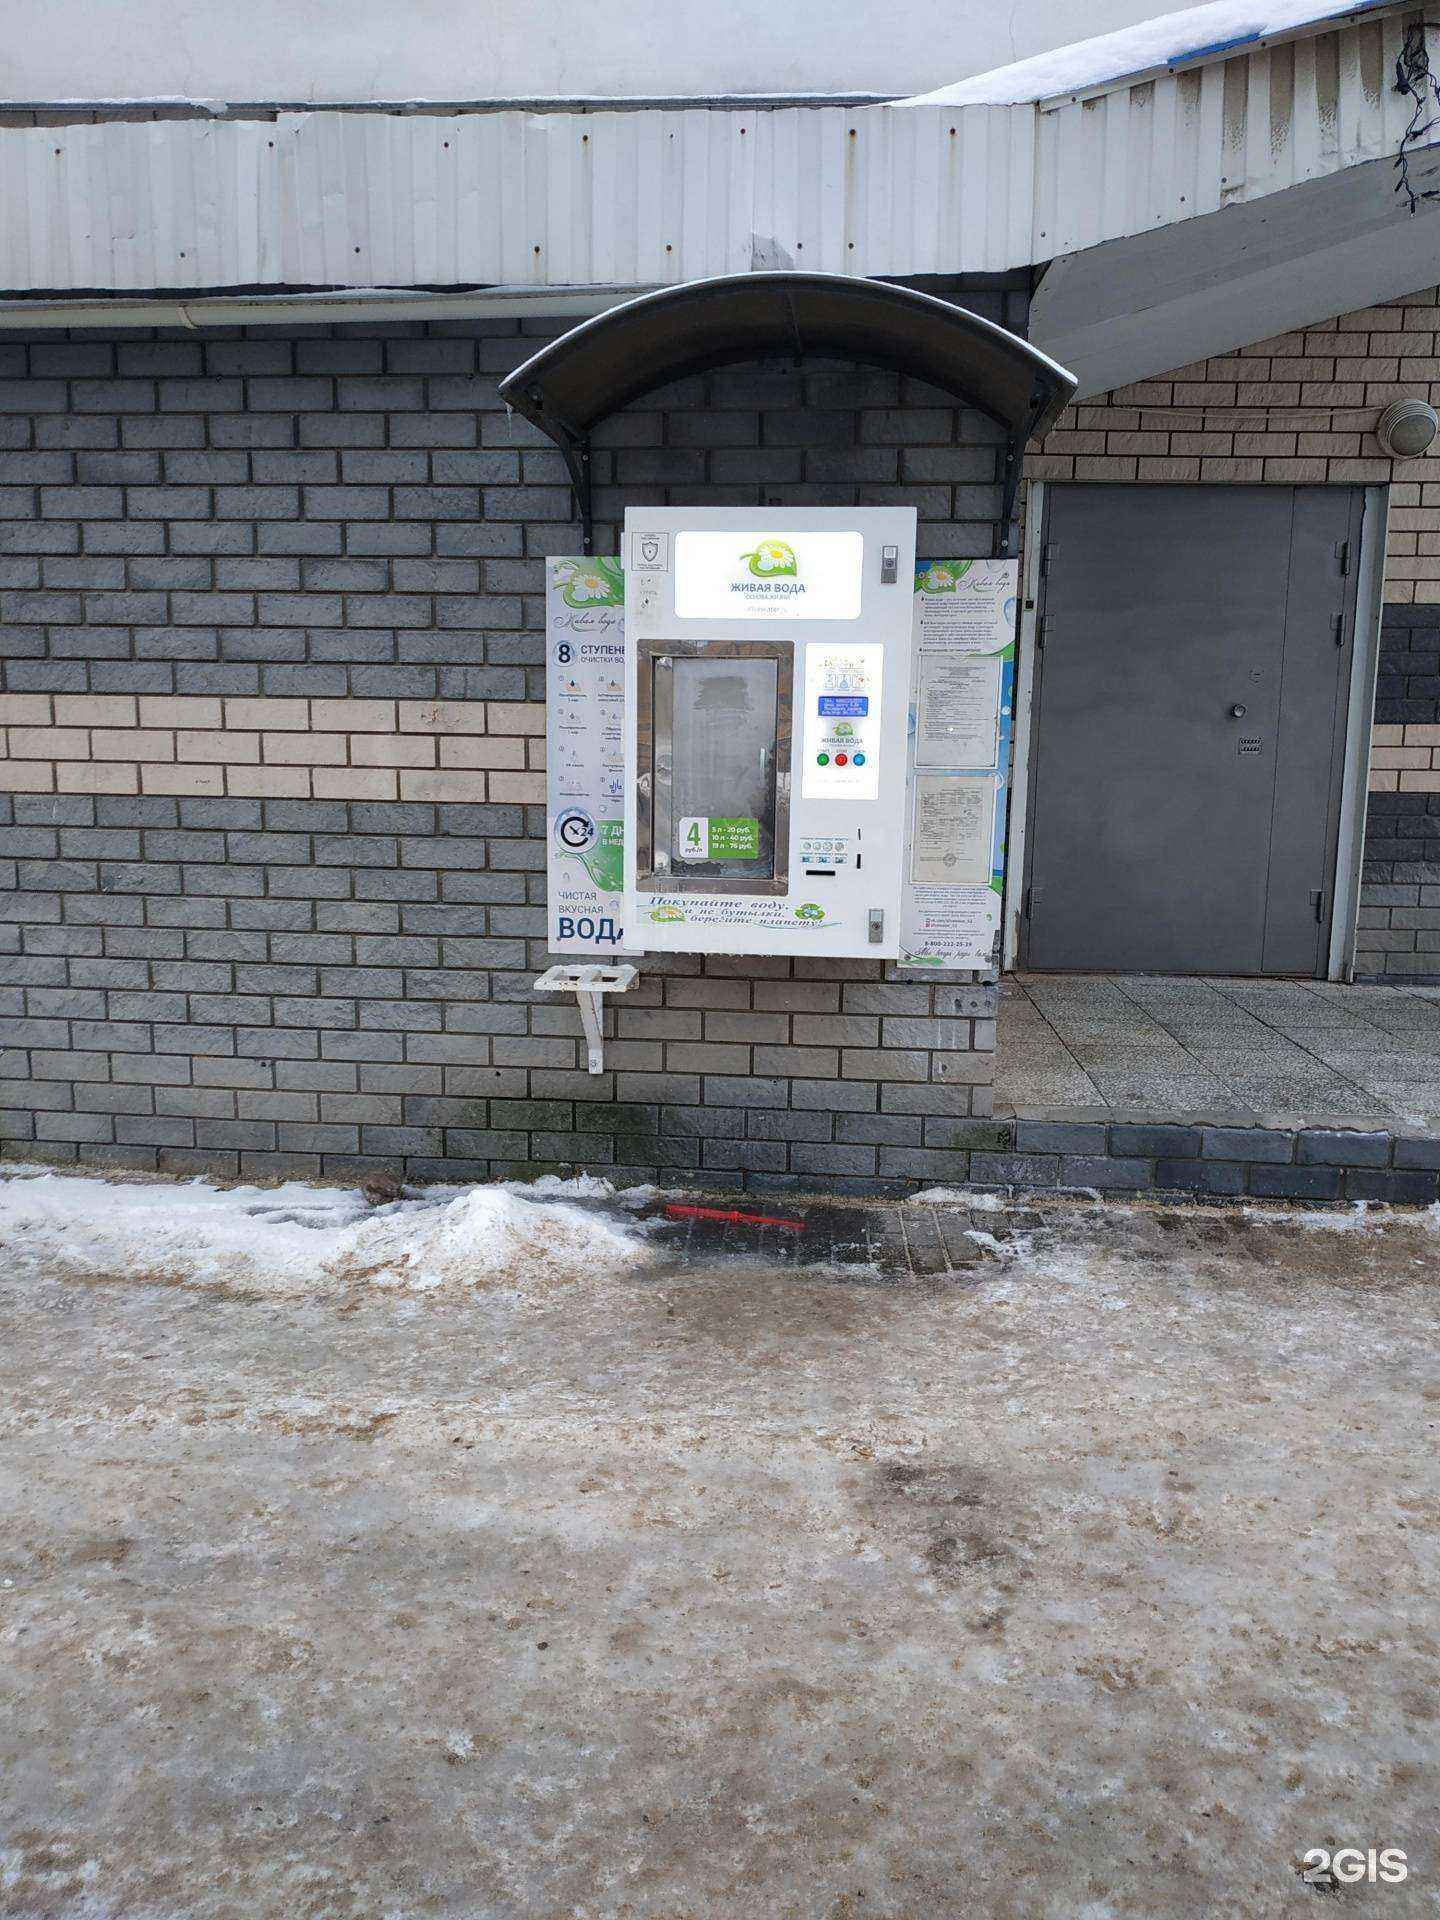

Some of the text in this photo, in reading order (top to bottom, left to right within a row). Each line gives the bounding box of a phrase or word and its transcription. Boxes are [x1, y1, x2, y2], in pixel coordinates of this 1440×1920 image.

[730, 583, 806, 594] ЖИВАЯ ВОДА
[558, 643, 571, 664] 8
[580, 656, 613, 664] ОЧИСТКИ
[580, 826, 594, 837] 24
[687, 822, 701, 846] 4
[558, 891, 597, 901] ЧИСТАЯ
[650, 896, 743, 909] Покупайте
[558, 905, 604, 914] ВКУСНАЯ
